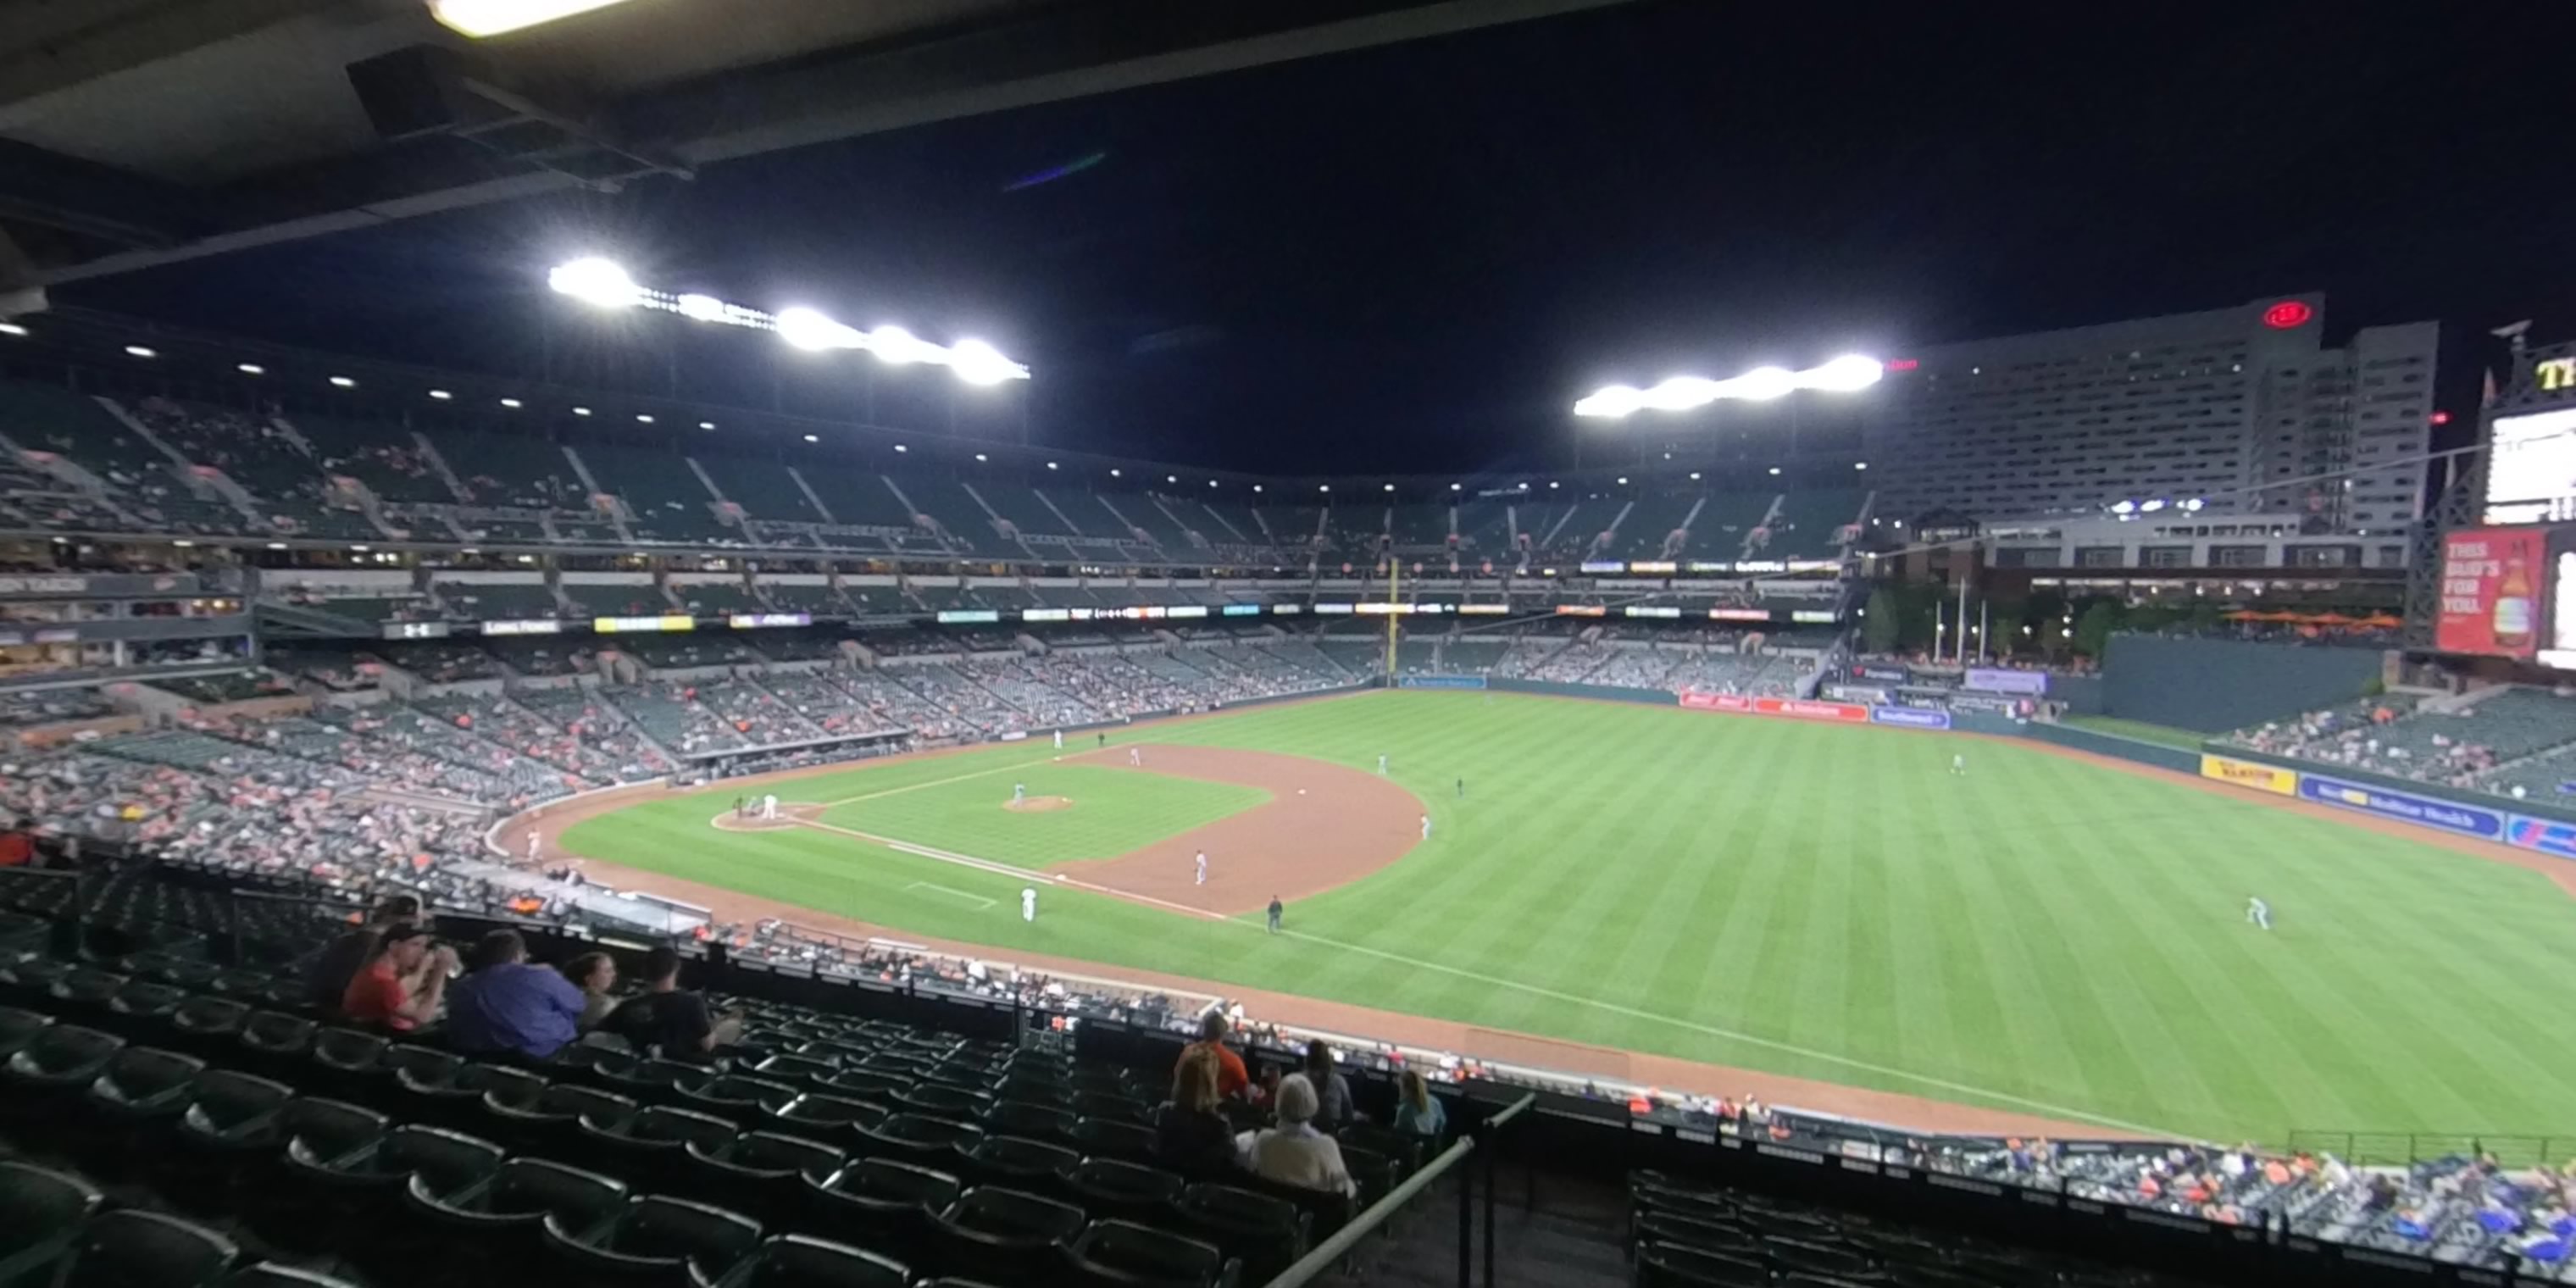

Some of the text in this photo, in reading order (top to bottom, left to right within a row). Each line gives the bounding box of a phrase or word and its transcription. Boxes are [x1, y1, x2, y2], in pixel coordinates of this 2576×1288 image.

[2449, 542, 2488, 558] THIS
[2446, 560, 2500, 577] BUD'S
[2444, 579, 2479, 595] FOR
